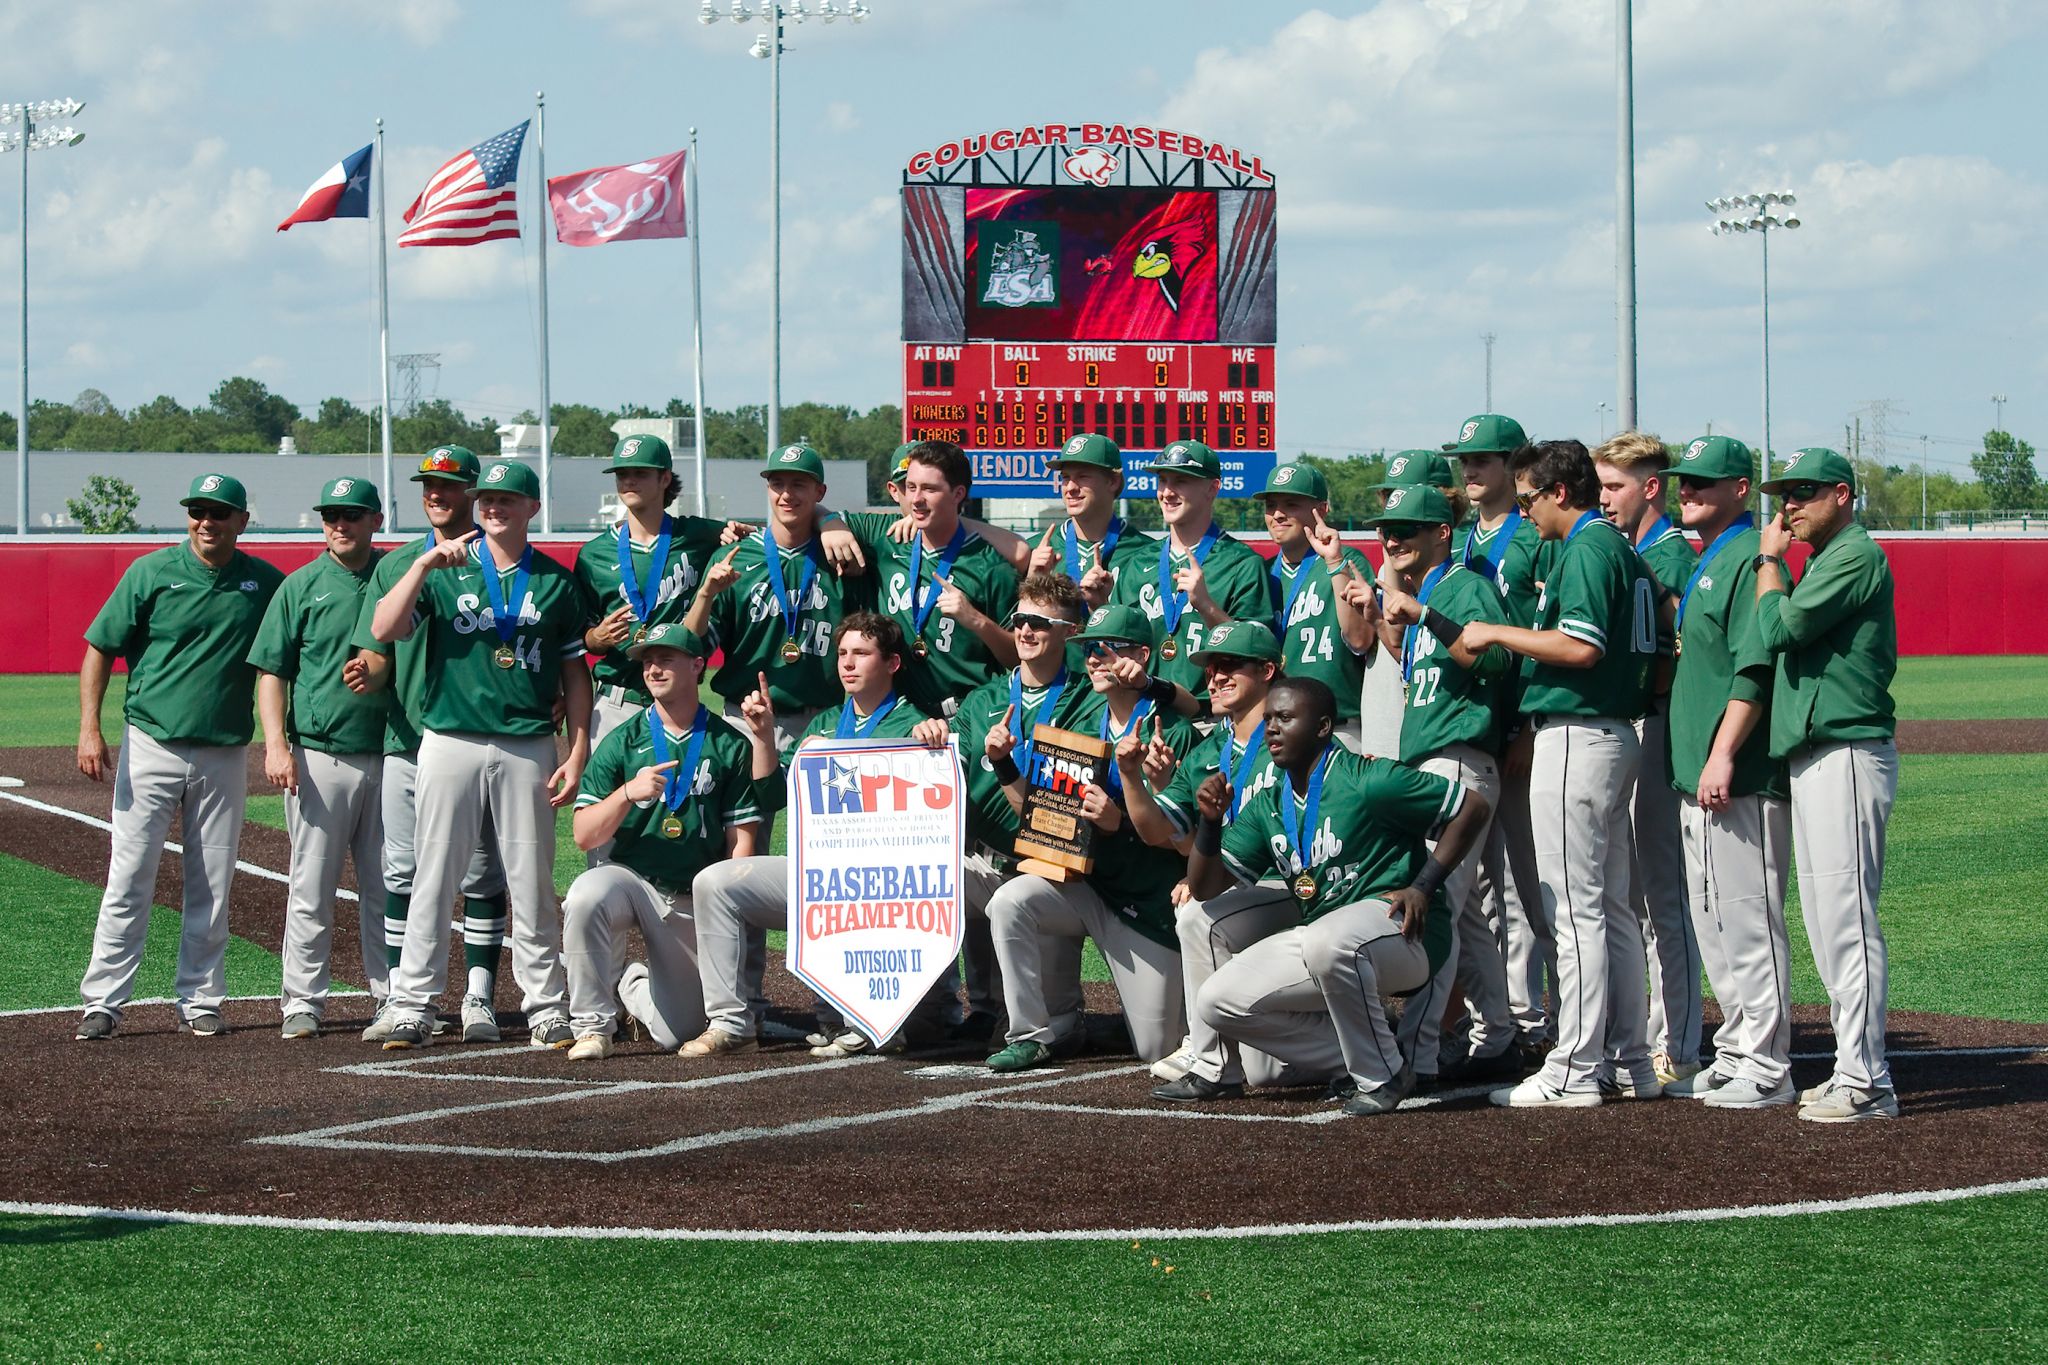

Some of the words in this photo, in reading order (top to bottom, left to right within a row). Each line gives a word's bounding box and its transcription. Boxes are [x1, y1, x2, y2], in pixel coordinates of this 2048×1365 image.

[907, 123, 1068, 177] COUGAR
[1081, 122, 1274, 183] BASEBALL
[983, 268, 1056, 307] LSA
[914, 346, 932, 361] AT
[936, 346, 963, 361] BAT
[1004, 347, 1040, 362] BALL
[1067, 347, 1116, 362] STRIKE
[1146, 347, 1175, 362] OUT
[1232, 348, 1256, 363] H/E
[1016, 362, 1029, 386] 0
[1085, 362, 1099, 386] 0
[1155, 362, 1168, 386] 0
[979, 390, 986, 403] 1
[996, 390, 1004, 403] 2
[1015, 390, 1023, 403] 3
[1037, 390, 1045, 403] 4
[1056, 390, 1064, 403] 5
[1074, 390, 1082, 403] 6
[1098, 390, 1105, 403] 7
[1116, 390, 1123, 403] 8
[1133, 390, 1141, 403] 9
[1154, 390, 1167, 403] 10
[1177, 390, 1209, 403] RUNS
[1219, 391, 1244, 403] HITS
[1251, 391, 1274, 403] ERR
[912, 404, 966, 421] PIONEERS
[972, 454, 1058, 478] IENDLY
[800, 618, 832, 657] 26
[936, 616, 955, 653] 3
[1186, 622, 1203, 657] 5
[1300, 626, 1334, 663] 24
[515, 635, 542, 672] 44
[1413, 667, 1440, 707] 22
[1038, 744, 1055, 755] TEXAS
[1056, 750, 1093, 766] ASSOCIATION
[1030, 752, 1094, 799] TAPPS
[800, 754, 954, 815] TAPPS
[1059, 804, 1082, 816] SCHOOL
[912, 834, 951, 846] HONOR
[805, 864, 954, 903] BASEBALL
[805, 900, 954, 941] CHAMPION
[844, 950, 908, 975] DIVISION
[911, 949, 922, 973] II
[868, 977, 900, 1001] 2019
